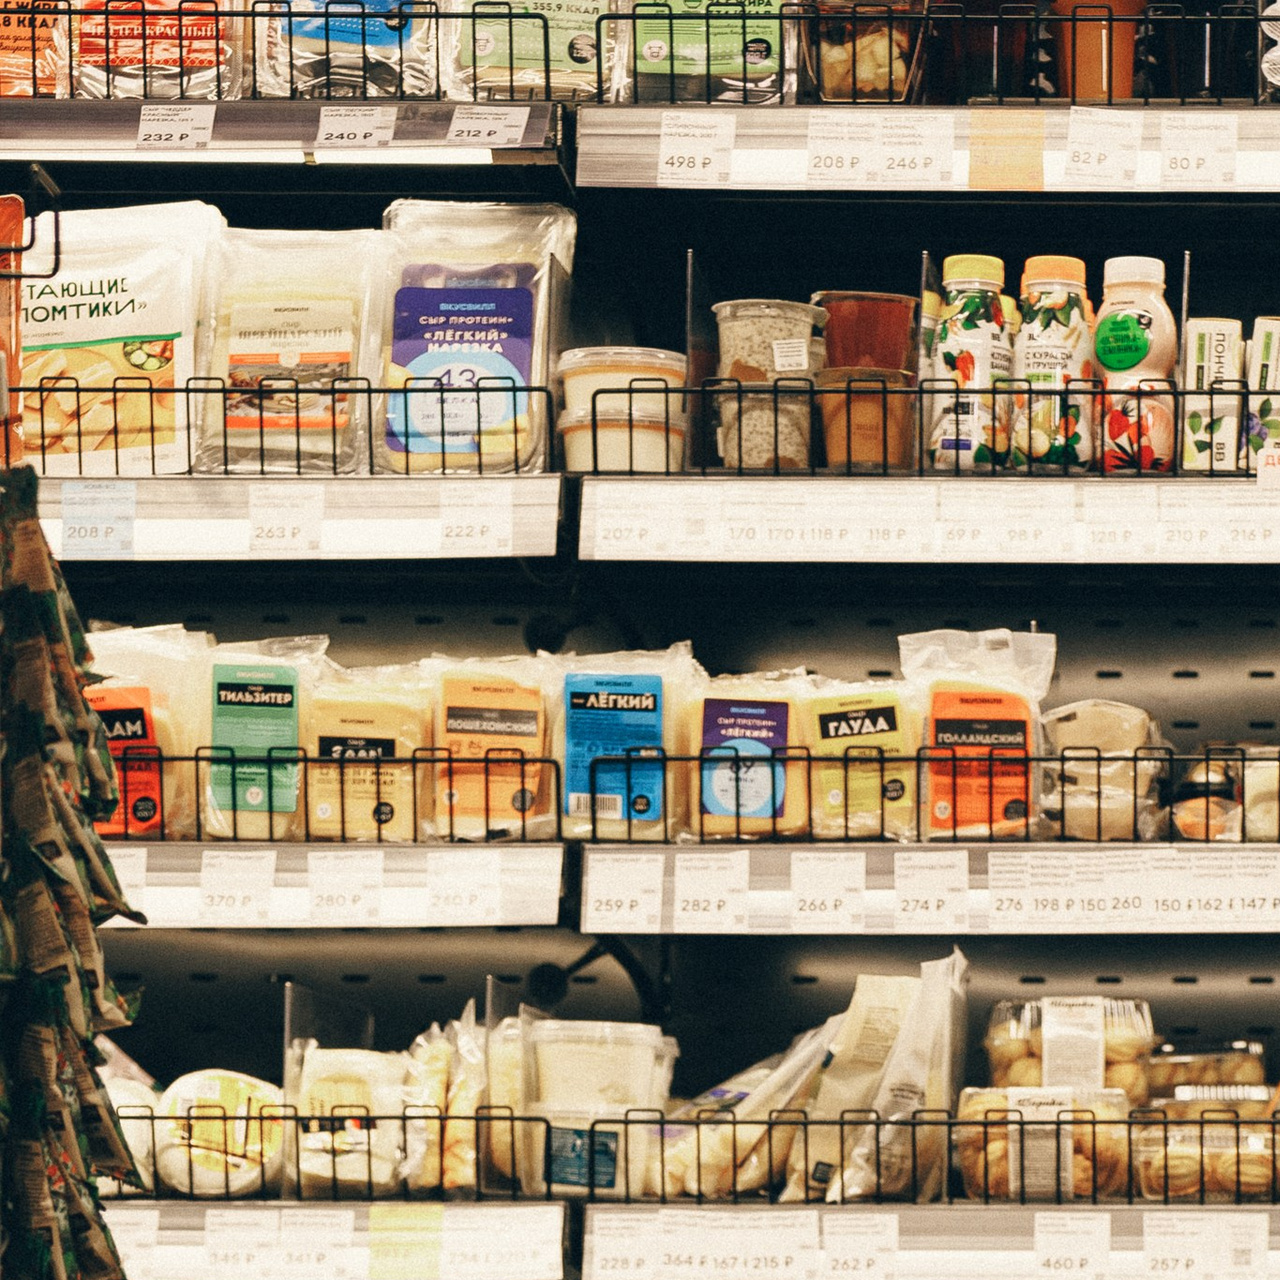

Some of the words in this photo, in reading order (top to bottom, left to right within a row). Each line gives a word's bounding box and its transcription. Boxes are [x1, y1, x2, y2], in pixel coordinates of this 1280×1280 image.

[566, 5, 600, 15] ККАЛ
[142, 133, 173, 142] 232
[323, 132, 357, 141] 240
[454, 128, 481, 138] 212
[665, 156, 696, 168] 498
[813, 156, 843, 168] 208
[1071, 151, 1090, 163] 82
[886, 158, 917, 170] 246
[427, 341, 503, 353] НАРЕЗКА
[218, 690, 293, 705] ТИЛЬЗИТЕР
[586, 692, 655, 709] ЛЁГКИЙ
[827, 717, 890, 736] ГАУДА
[937, 731, 1023, 745] ГОЛЛАНДСКИЙ
[594, 899, 622, 911] 259
[681, 899, 710, 911] 282
[799, 899, 827, 911] 266
[901, 899, 929, 911] 274
[995, 898, 1023, 911] 276
[1111, 896, 1142, 909] 260
[1240, 897, 1265, 910] 147
